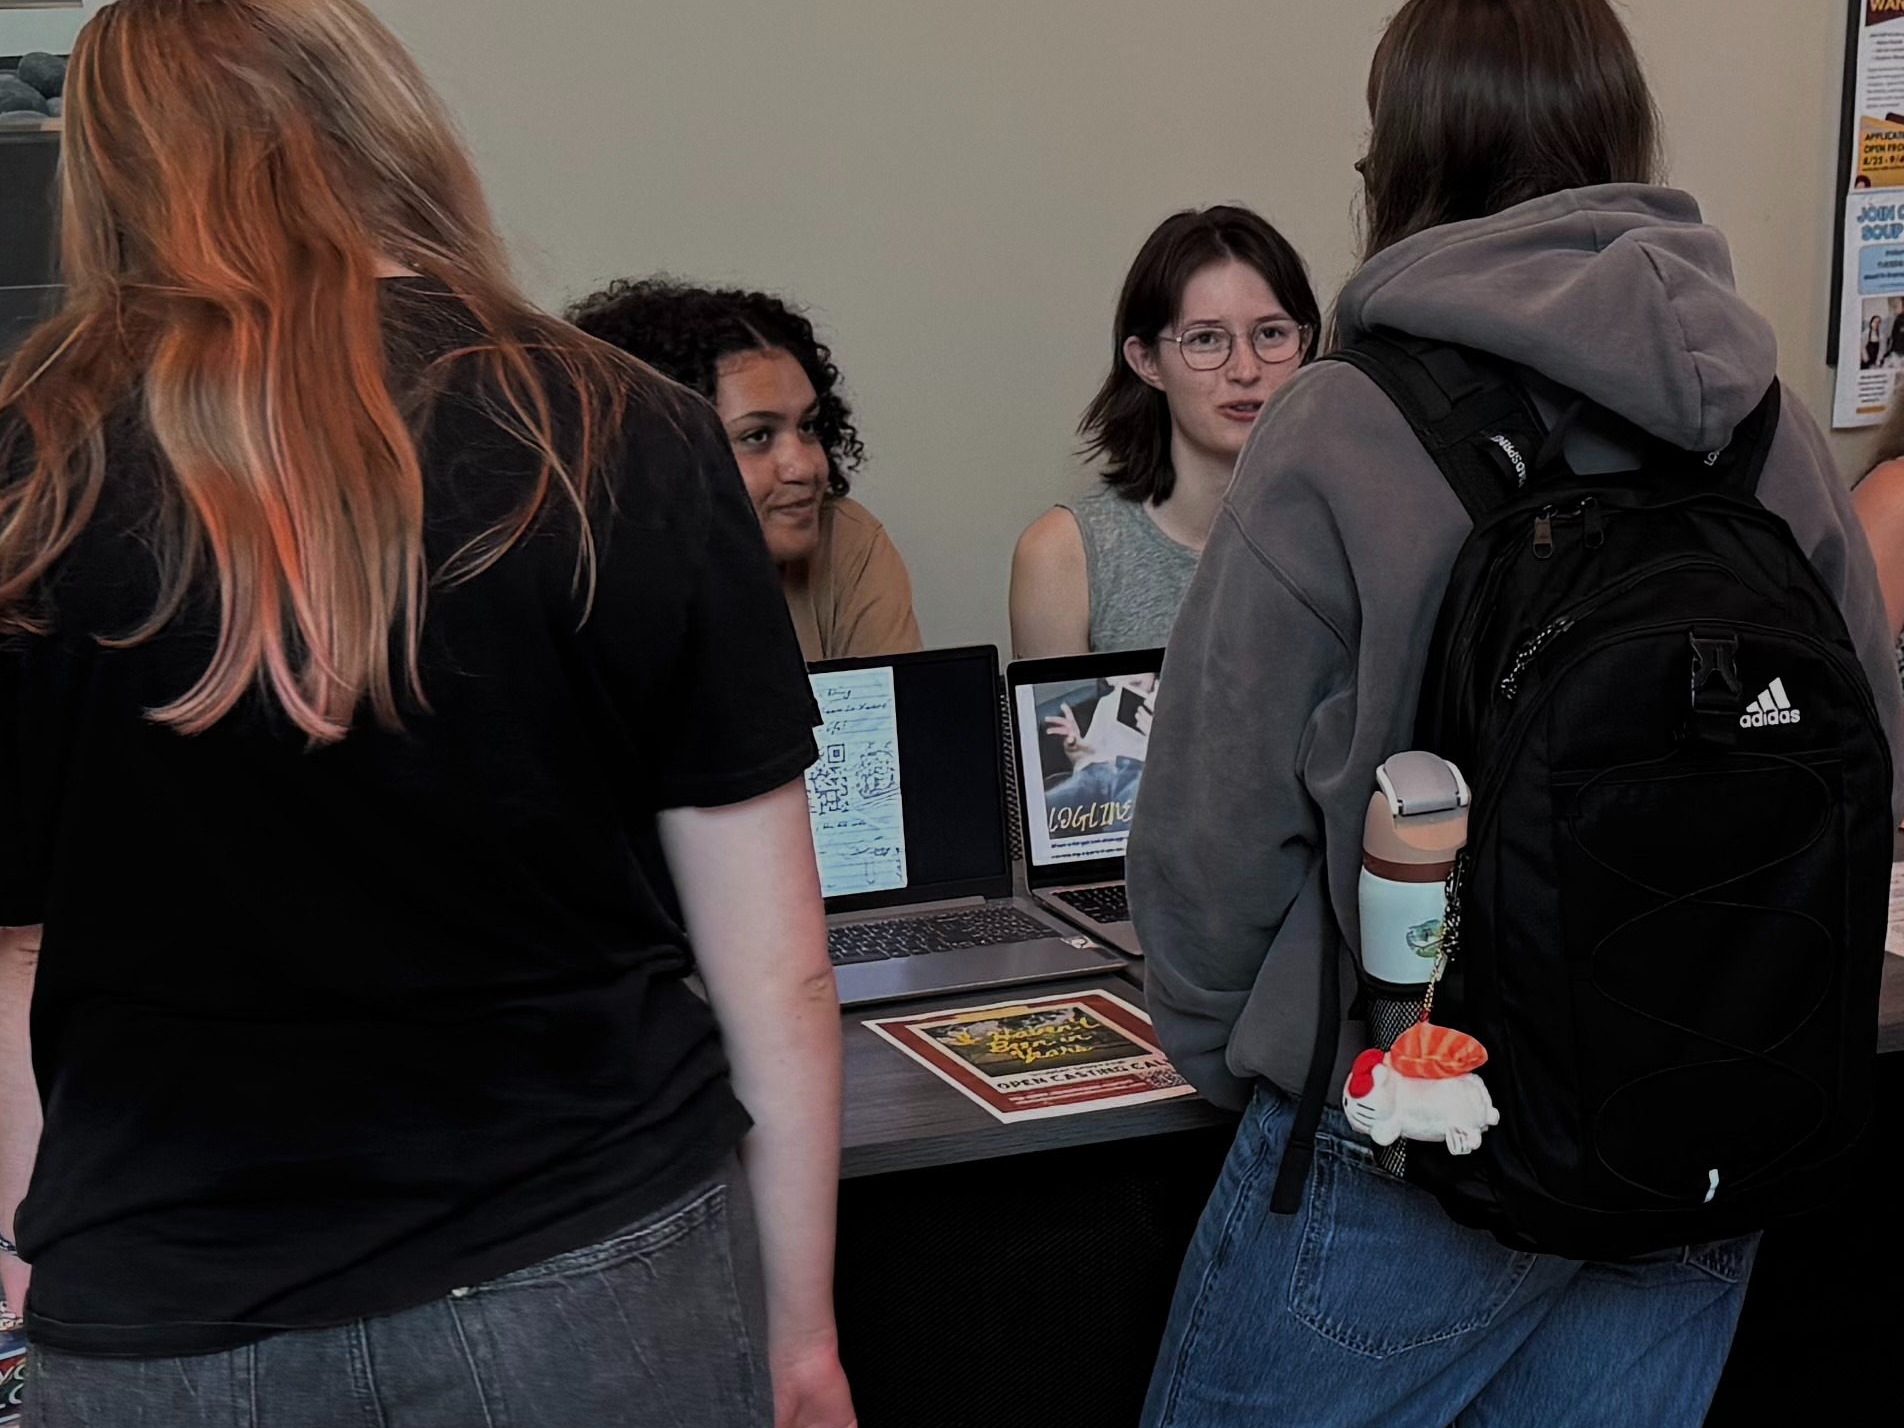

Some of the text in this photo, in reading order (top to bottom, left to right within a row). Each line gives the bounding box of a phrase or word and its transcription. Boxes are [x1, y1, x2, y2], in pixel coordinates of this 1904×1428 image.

[1863, 144, 1886, 154] OPEN
[1856, 204, 1895, 223] JOIN
[1861, 223, 1904, 241] SOUP
[1739, 707, 1801, 729] adidas
[1048, 798, 1133, 833] LOGLINE
[997, 1077, 1046, 1090] OPEN
[1049, 1064, 1129, 1083] CASTING
